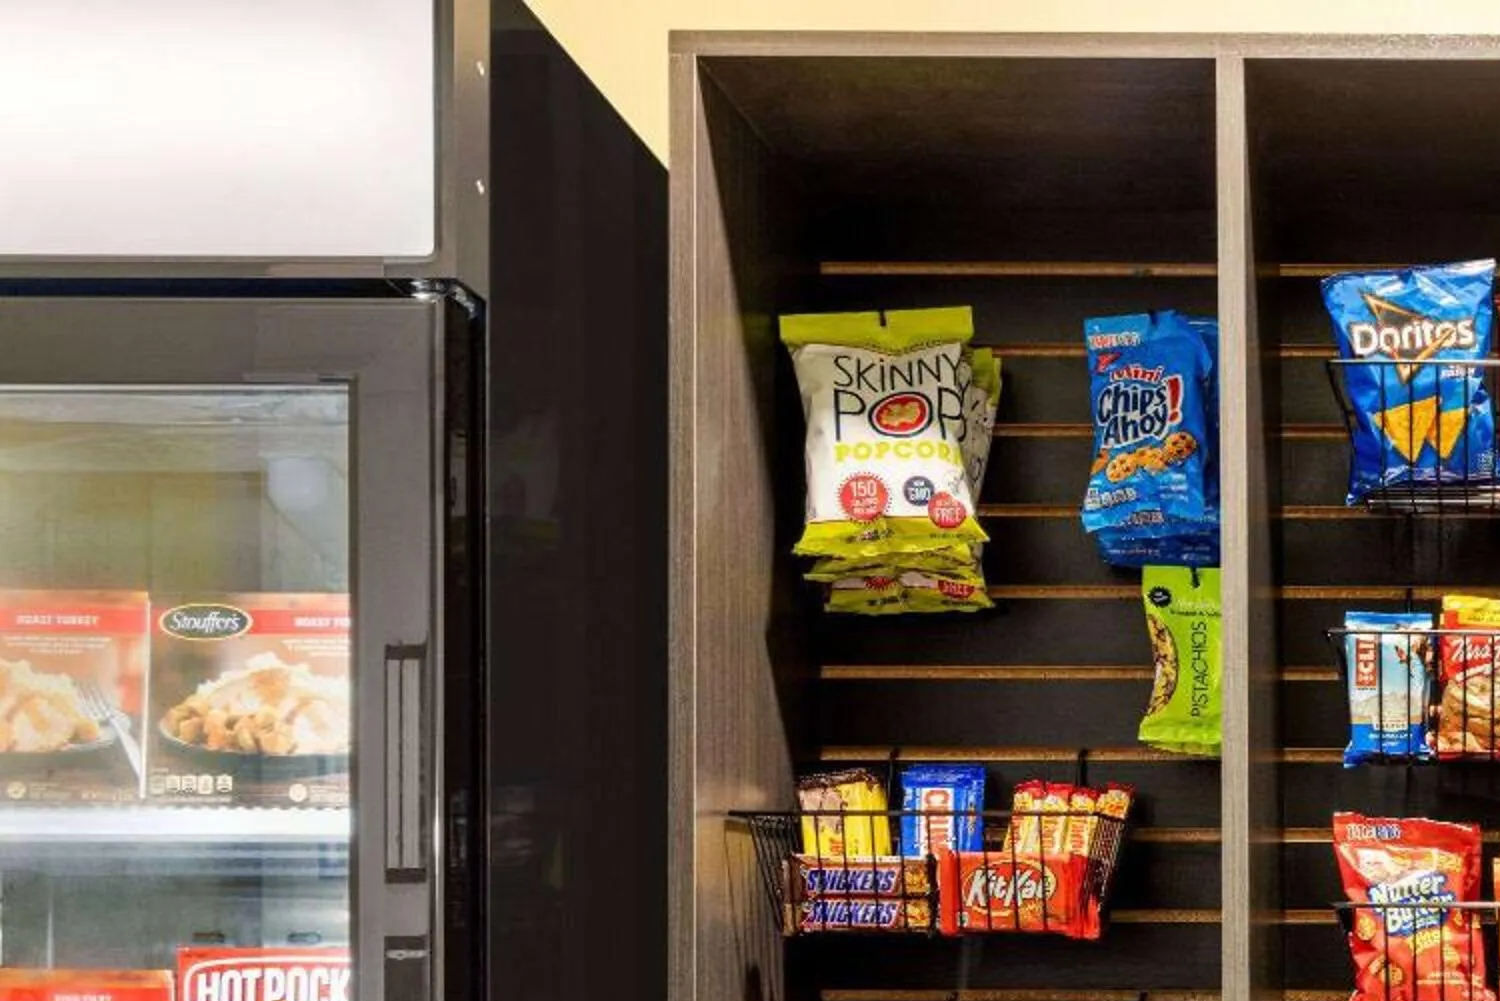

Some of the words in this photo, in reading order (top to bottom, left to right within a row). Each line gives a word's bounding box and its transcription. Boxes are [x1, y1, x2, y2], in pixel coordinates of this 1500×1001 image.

[1350, 319, 1473, 356] Doritos
[833, 387, 967, 442] POP
[1097, 382, 1168, 425] Chips
[851, 480, 877, 497] 150
[170, 610, 241, 633] Stouffer's
[1191, 621, 1208, 717] PISTACHIOS
[807, 869, 896, 892] SNICKERS
[1370, 873, 1446, 905] Nutter
[809, 900, 897, 925] SNICKERS
